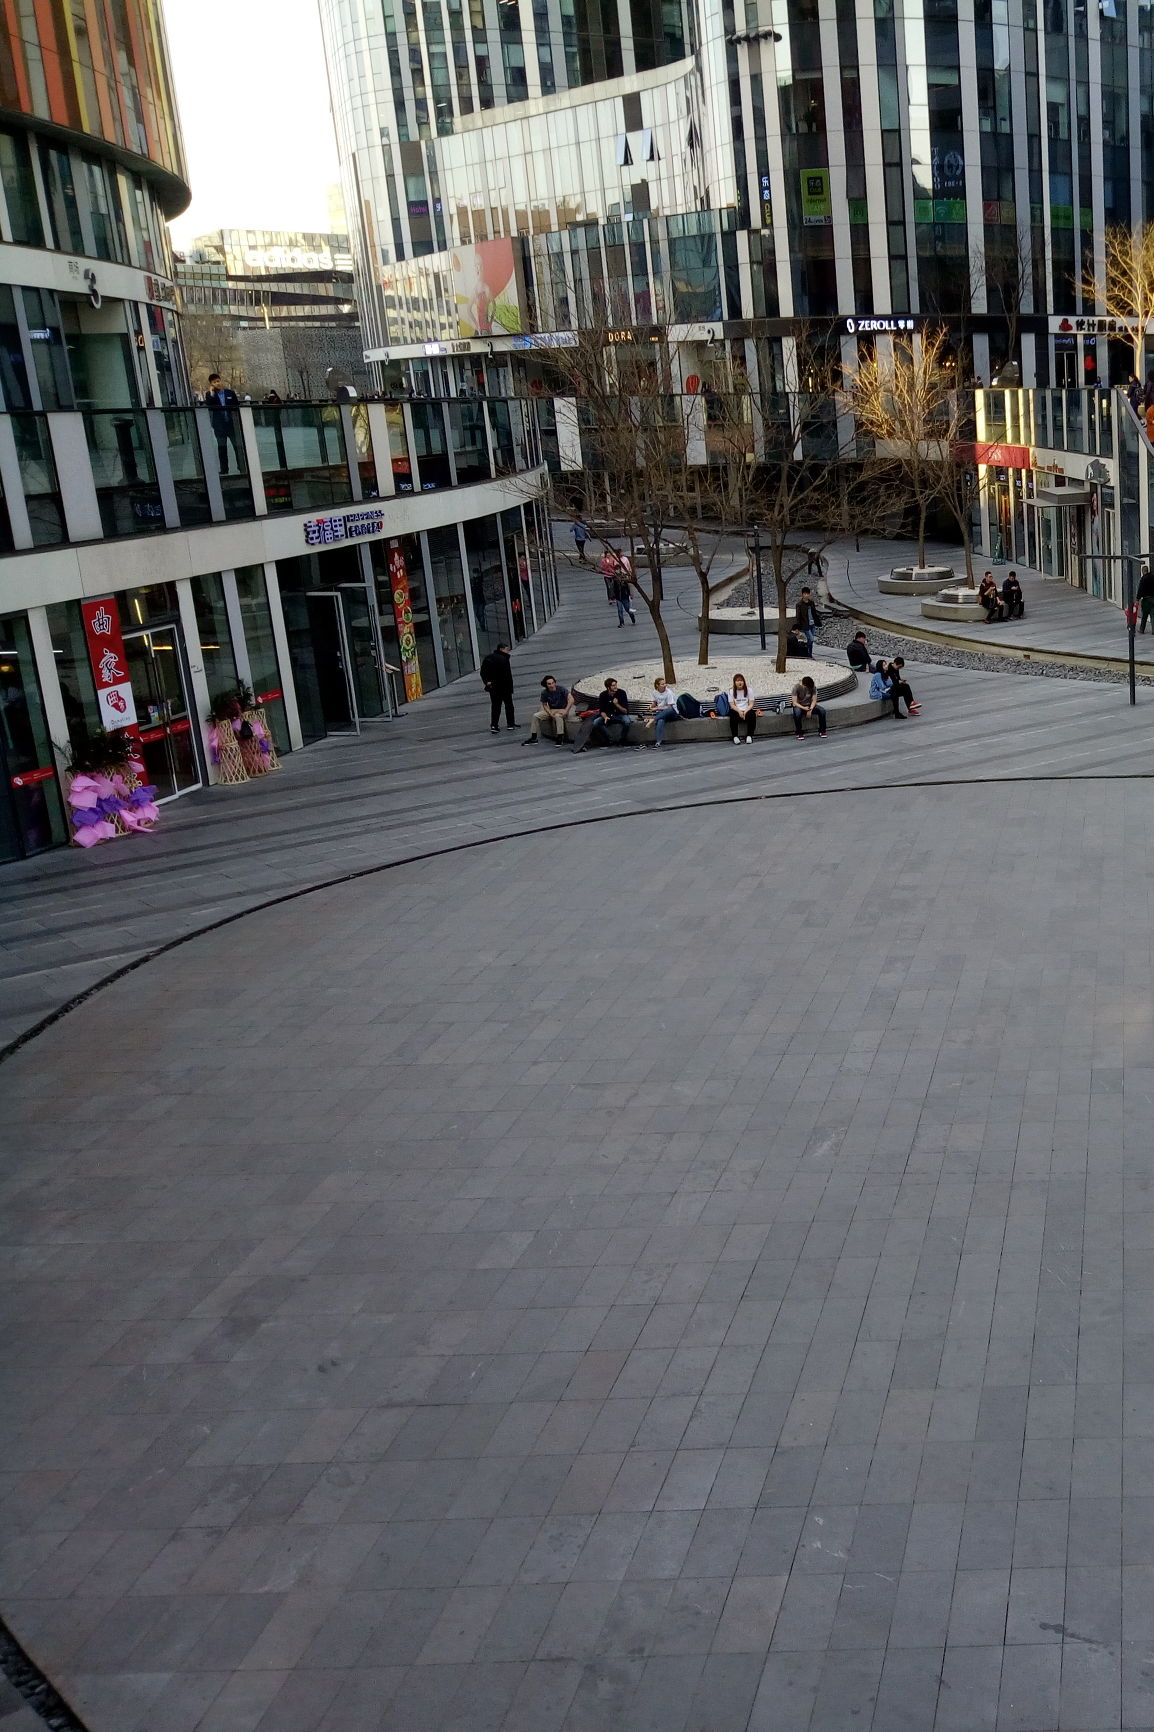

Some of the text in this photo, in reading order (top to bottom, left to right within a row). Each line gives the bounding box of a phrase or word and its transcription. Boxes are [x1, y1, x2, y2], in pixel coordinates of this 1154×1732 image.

[245, 246, 334, 270] adidas
[857, 319, 897, 331] ZEROLL
[608, 331, 632, 343] DORA
[706, 327, 716, 347] 2
[304, 518, 345, 545] 幸福里
[91, 606, 125, 684] 曲家
